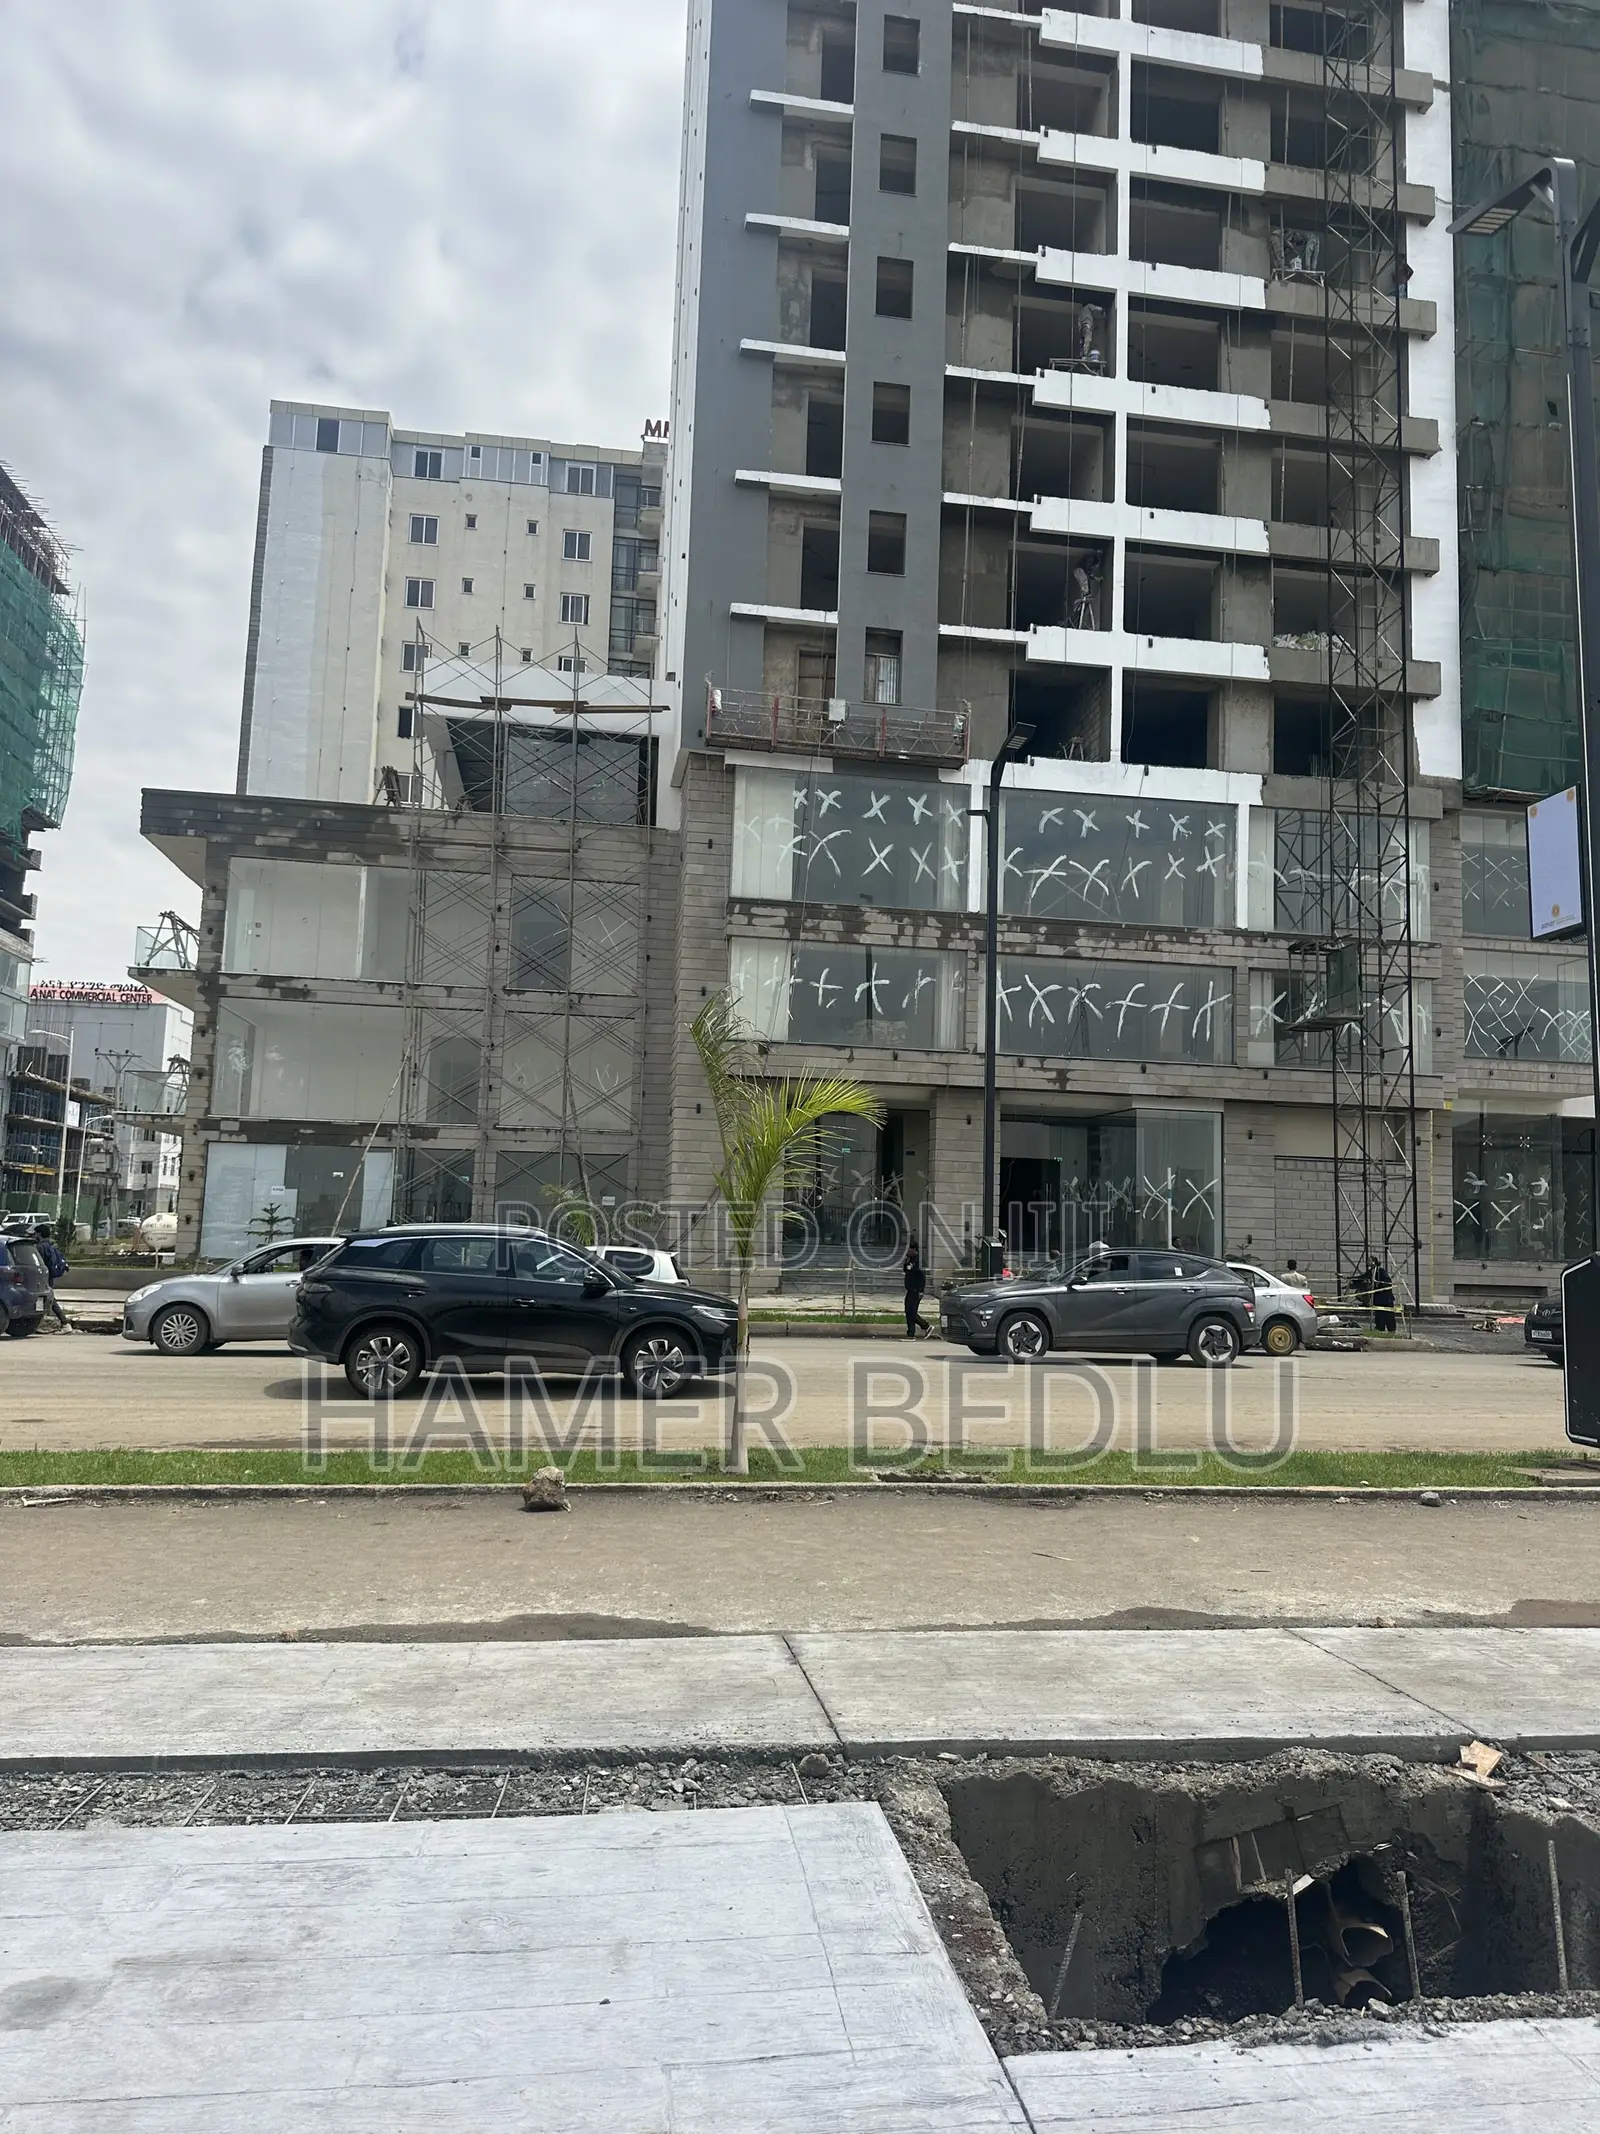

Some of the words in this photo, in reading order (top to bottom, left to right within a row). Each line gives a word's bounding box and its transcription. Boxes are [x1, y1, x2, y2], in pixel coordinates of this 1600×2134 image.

[30, 988, 57, 999] ANAT
[60, 990, 117, 1001] COMMERCIAL
[120, 993, 152, 1003] CENTER
